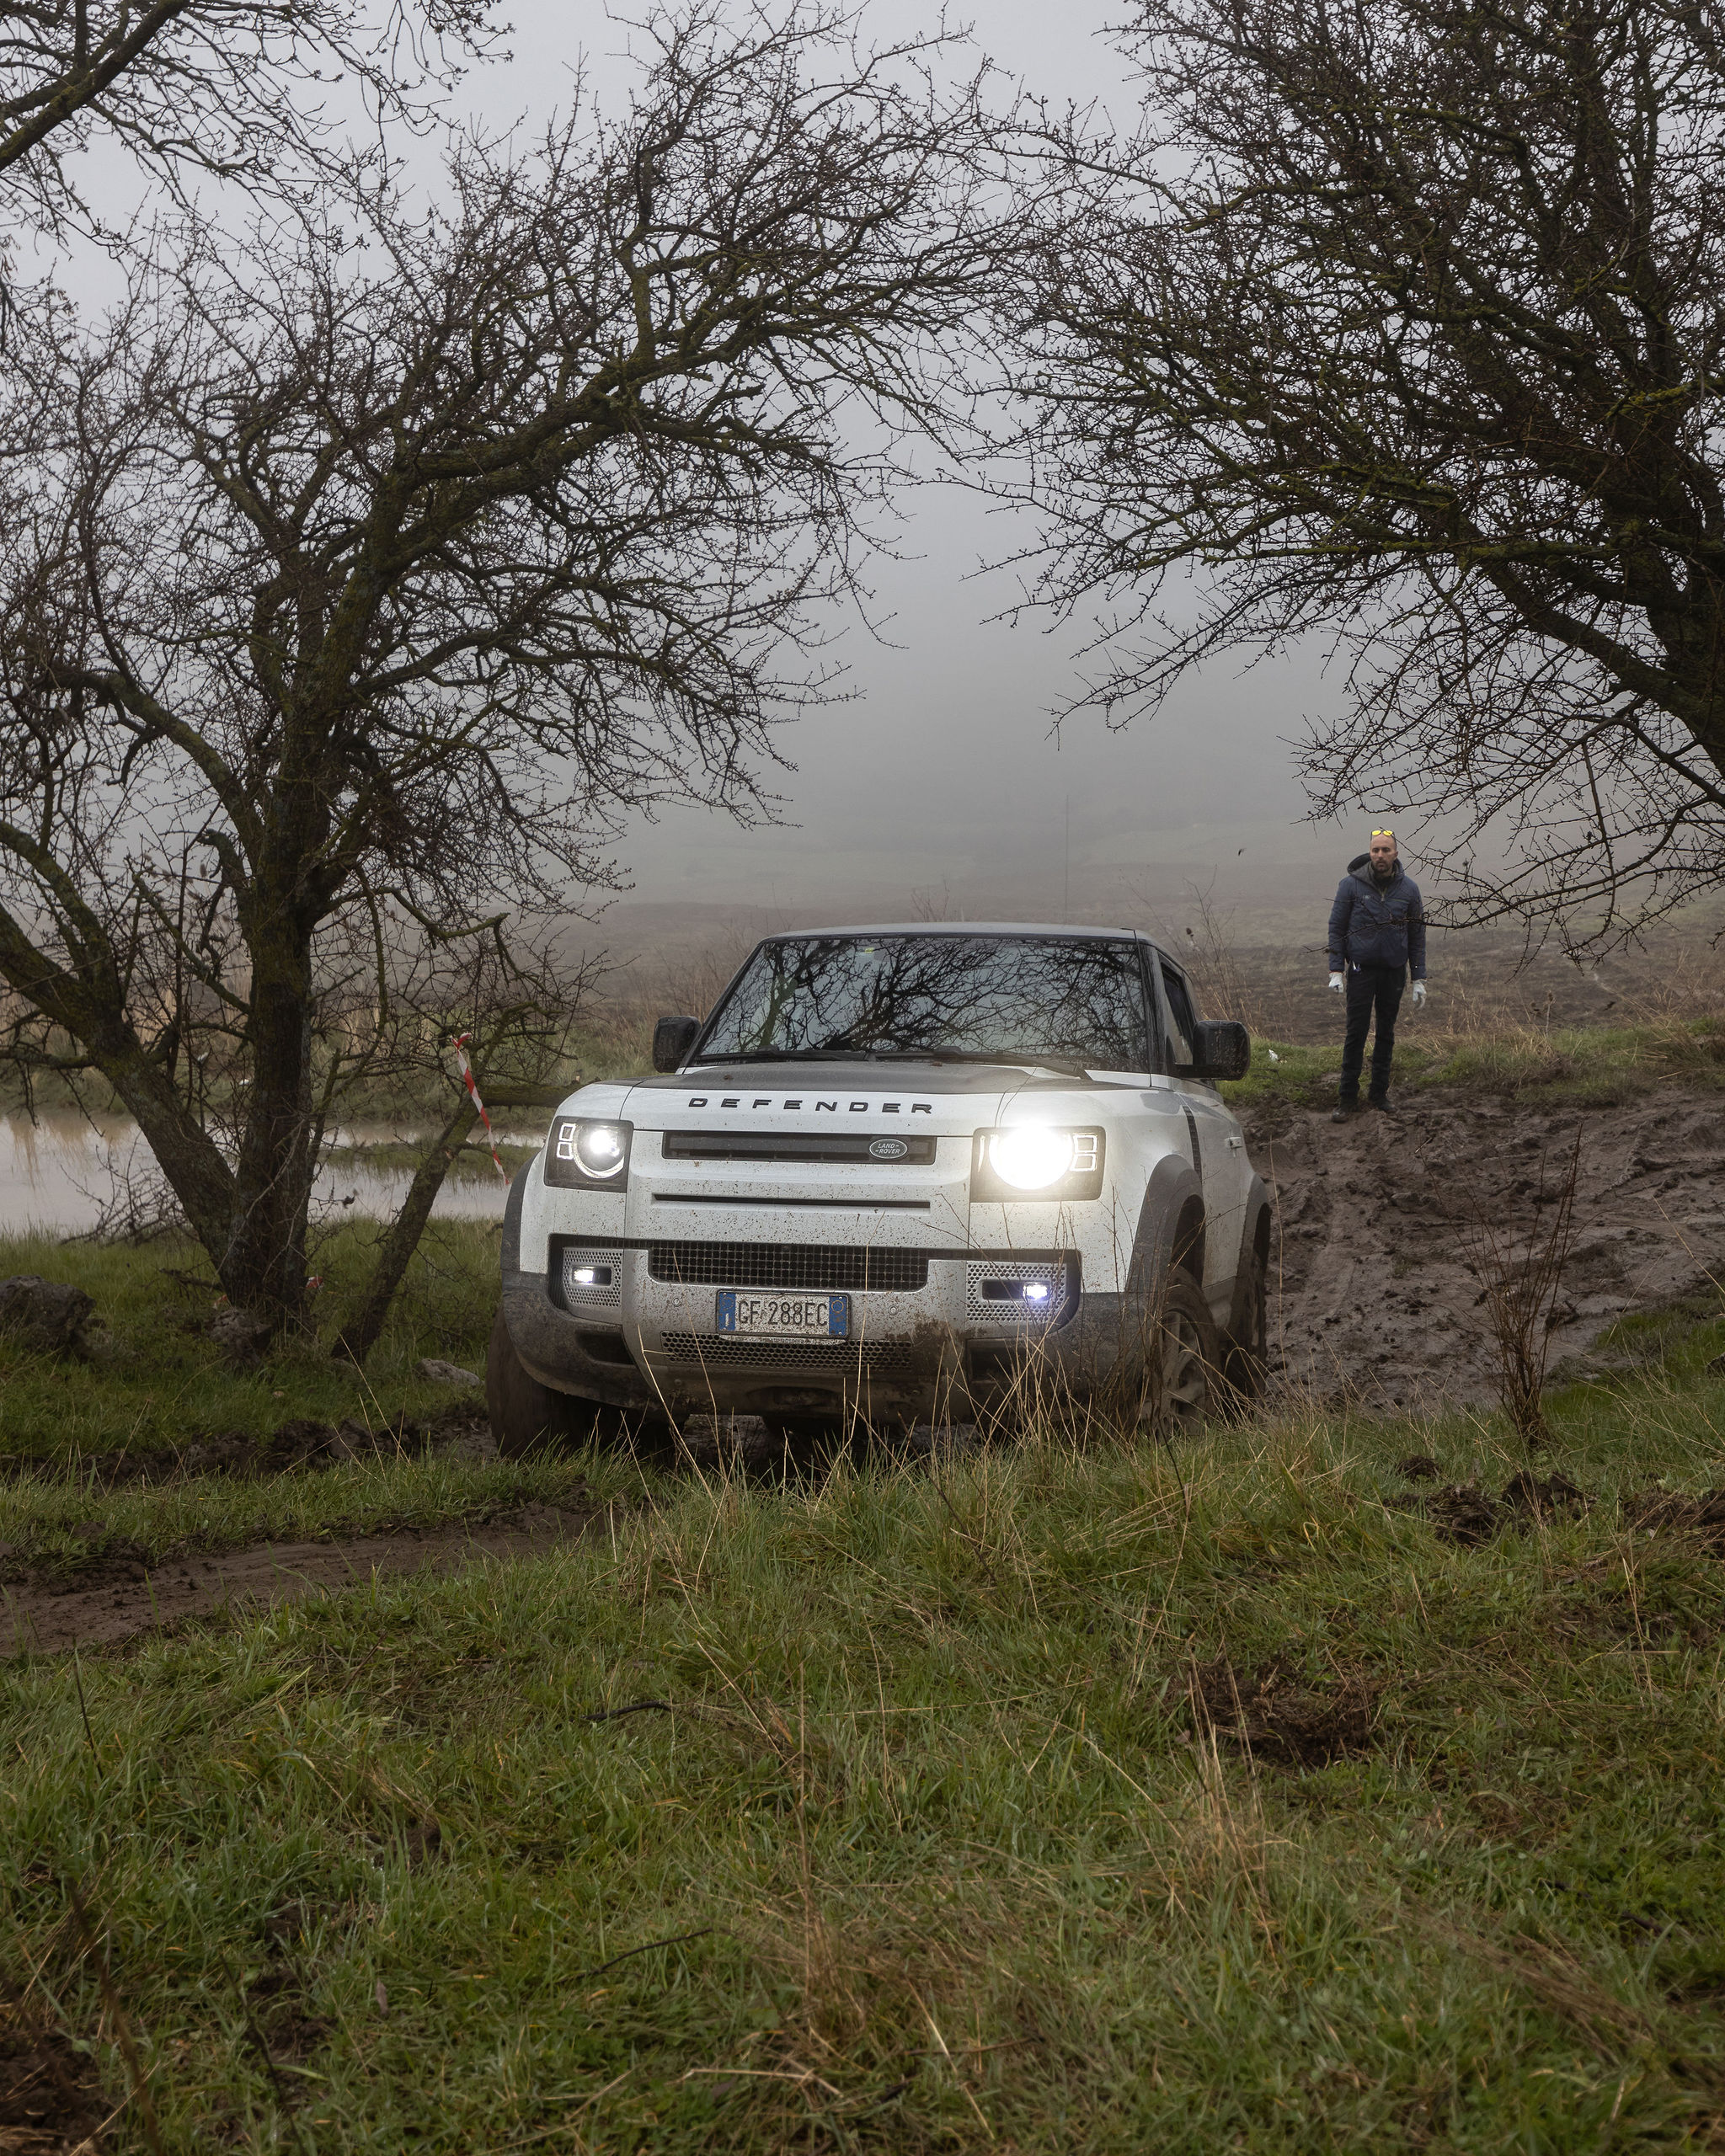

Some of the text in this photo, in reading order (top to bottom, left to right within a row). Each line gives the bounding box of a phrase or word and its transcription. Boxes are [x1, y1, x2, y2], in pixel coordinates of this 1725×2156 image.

[688, 1097, 932, 1114] DEFENDER
[738, 1300, 828, 1326] GF 288EC
